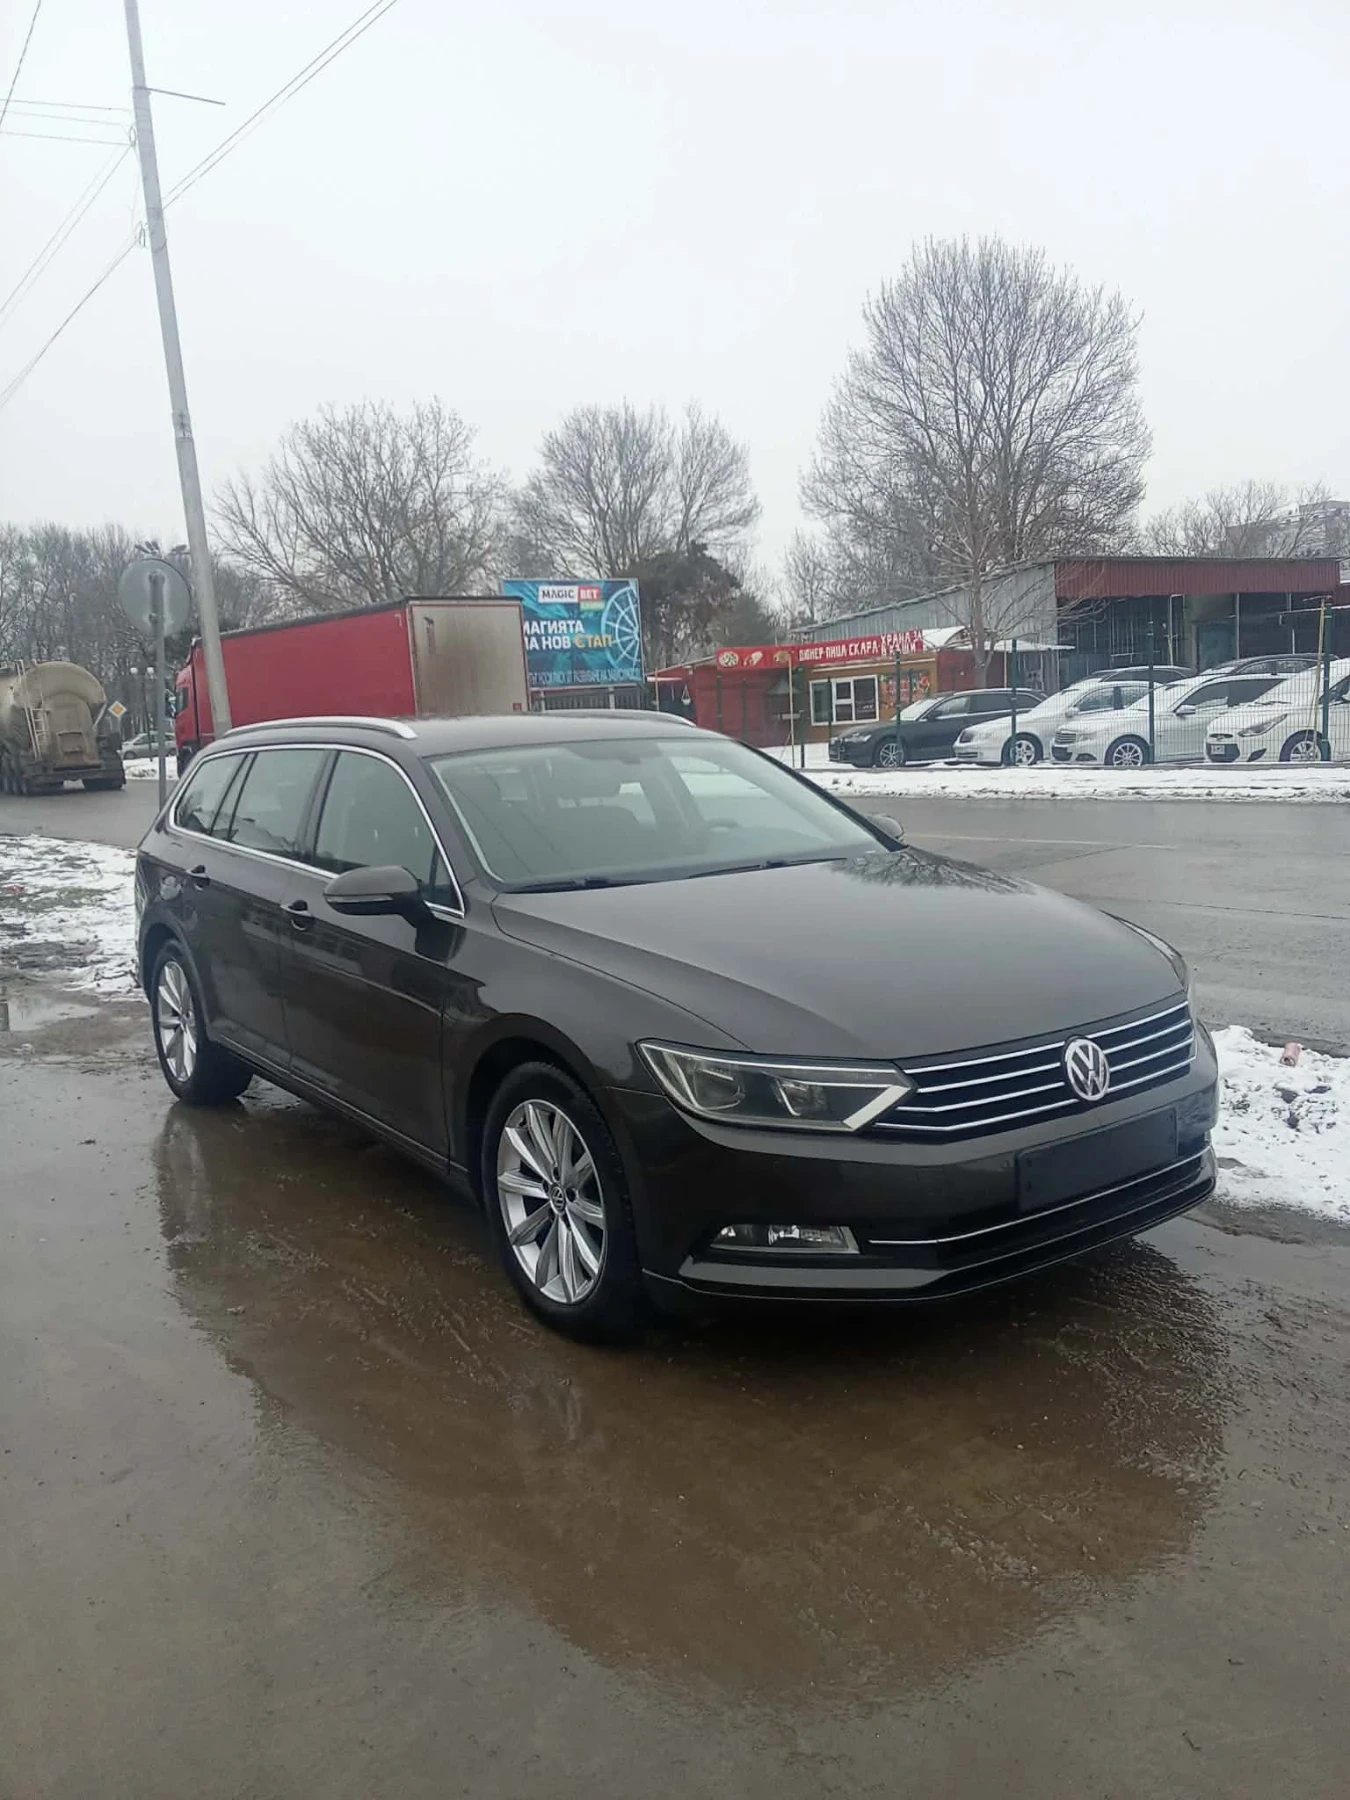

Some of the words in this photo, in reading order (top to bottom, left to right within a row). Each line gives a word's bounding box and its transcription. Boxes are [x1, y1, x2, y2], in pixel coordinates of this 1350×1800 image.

[542, 589, 575, 599] MAGIC
[580, 589, 598, 599] BET
[542, 636, 571, 650] НОВ
